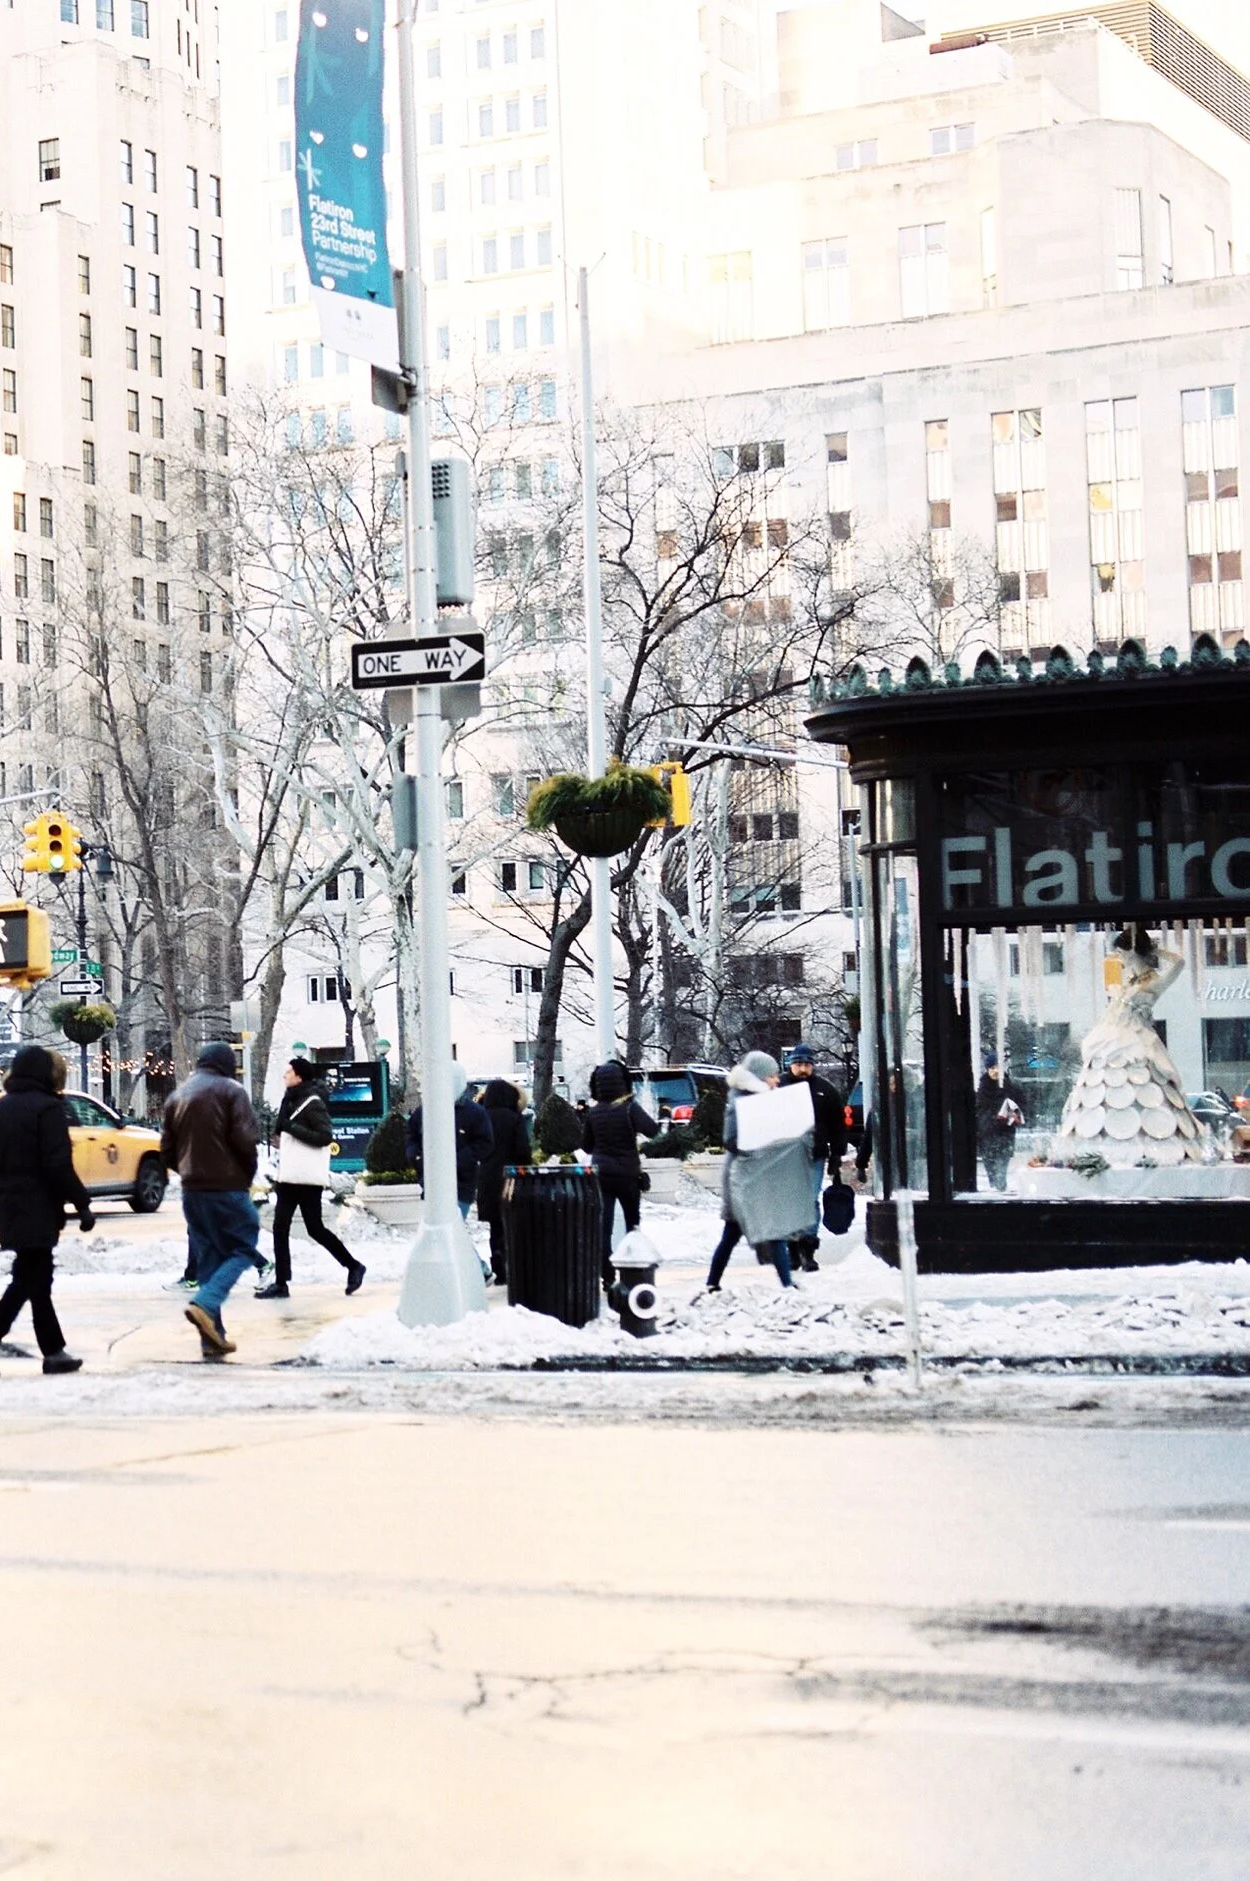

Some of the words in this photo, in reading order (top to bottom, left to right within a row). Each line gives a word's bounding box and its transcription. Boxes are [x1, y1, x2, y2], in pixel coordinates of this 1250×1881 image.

[308, 193, 354, 222] Flatiron
[311, 212, 339, 235] 23rd
[340, 220, 376, 246] Street
[312, 229, 377, 265] Partnership
[363, 654, 401, 675] ONE
[425, 648, 467, 670] WAY
